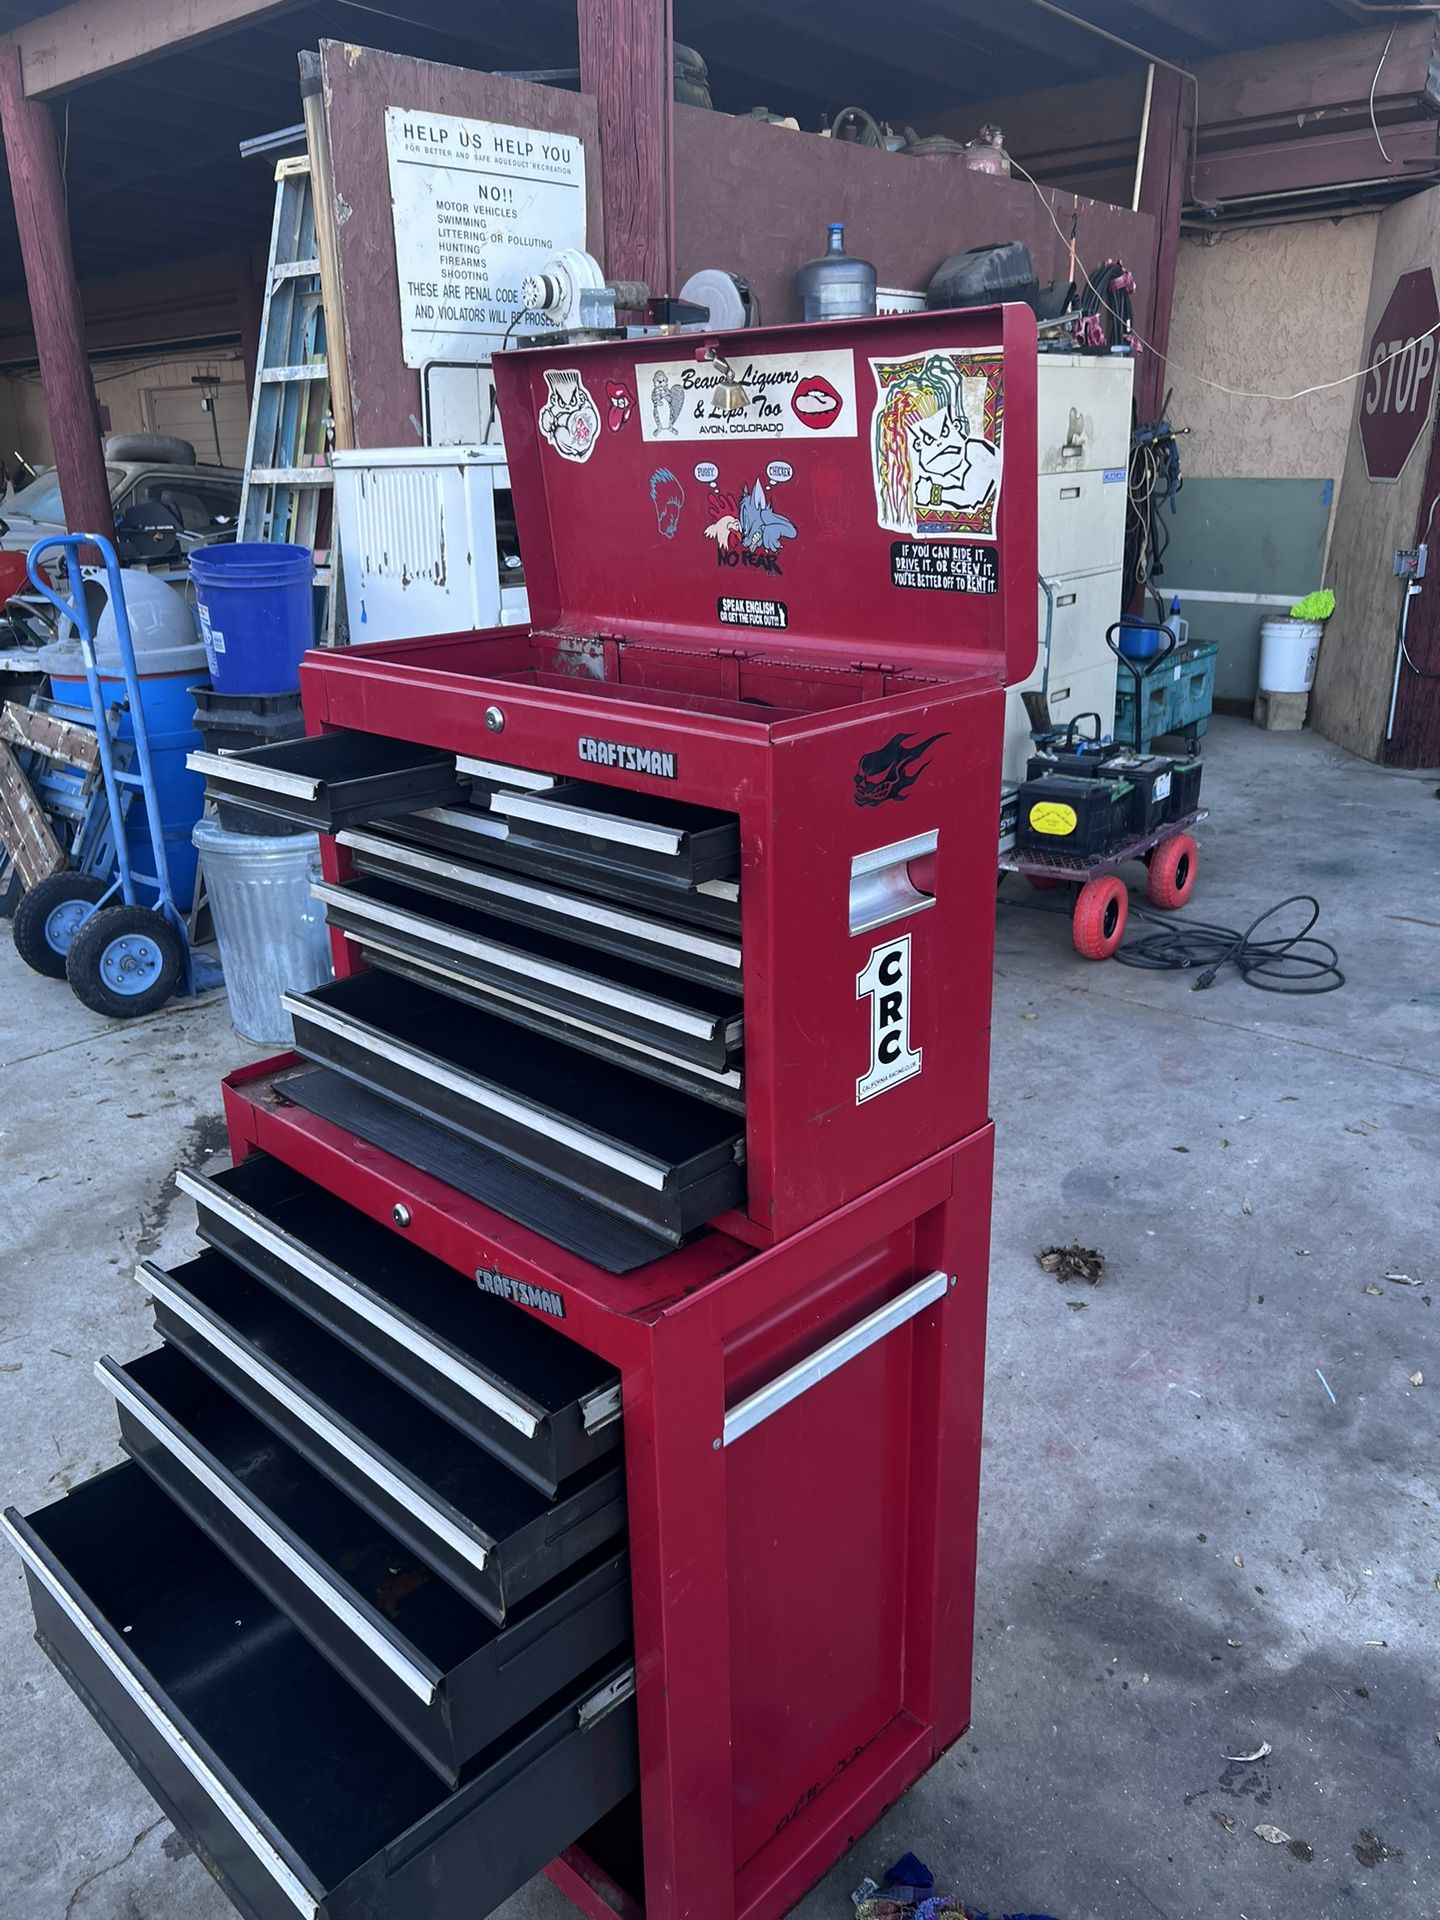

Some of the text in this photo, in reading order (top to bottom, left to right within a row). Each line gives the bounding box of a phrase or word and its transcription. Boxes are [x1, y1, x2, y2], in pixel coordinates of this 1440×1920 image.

[404, 123, 570, 163] HELP US HELP YOU
[405, 144, 571, 175] FOR BETTER AND SAFE AQUEDUCT RECREATION
[478, 184, 513, 203] NO!!
[436, 201, 517, 218] MOTOR VEHICLES
[437, 214, 486, 228] SWIMMING
[438, 228, 552, 249] LITTERING OR POLLUTING
[438, 242, 480, 254] HUNTING
[440, 255, 487, 267] FIREARMS
[441, 269, 488, 281] SHOOTING
[408, 281, 518, 303] THESE ARE PENAL CODE
[415, 305, 434, 319] AND
[438, 306, 485, 322] VIOLATORS
[489, 309, 507, 324] WILL
[511, 311, 521, 325] BE
[681, 364, 799, 393] Beave Liquors
[1365, 334, 1434, 415] STOP
[694, 400, 704, 418] &
[752, 395, 782, 418] Too
[699, 423, 783, 434] AVON, COLORADO
[717, 547, 783, 575] NO FEAR
[902, 544, 909, 556] IF
[912, 545, 929, 558] YOU
[932, 546, 950, 559] CAN
[952, 547, 972, 561] RIDE
[895, 557, 919, 571] DRIVE
[936, 560, 947, 572] OR
[951, 562, 980, 575] SCREW
[917, 573, 942, 588] BETTER
[943, 576, 954, 589] OFF
[956, 577, 965, 590] TO
[966, 575, 987, 592] RENT
[722, 598, 775, 615] SPEAK ENGLISH
[720, 611, 728, 621] OR
[728, 612, 738, 622] GET
[738, 612, 749, 623] THE
[749, 614, 763, 625] FUCK
[578, 737, 675, 778] CRAFTSMAN
[878, 950, 903, 1065] CRC
[862, 1075, 888, 1092] CALIFORNIA
[475, 1269, 563, 1317] CRAFTSMAN
